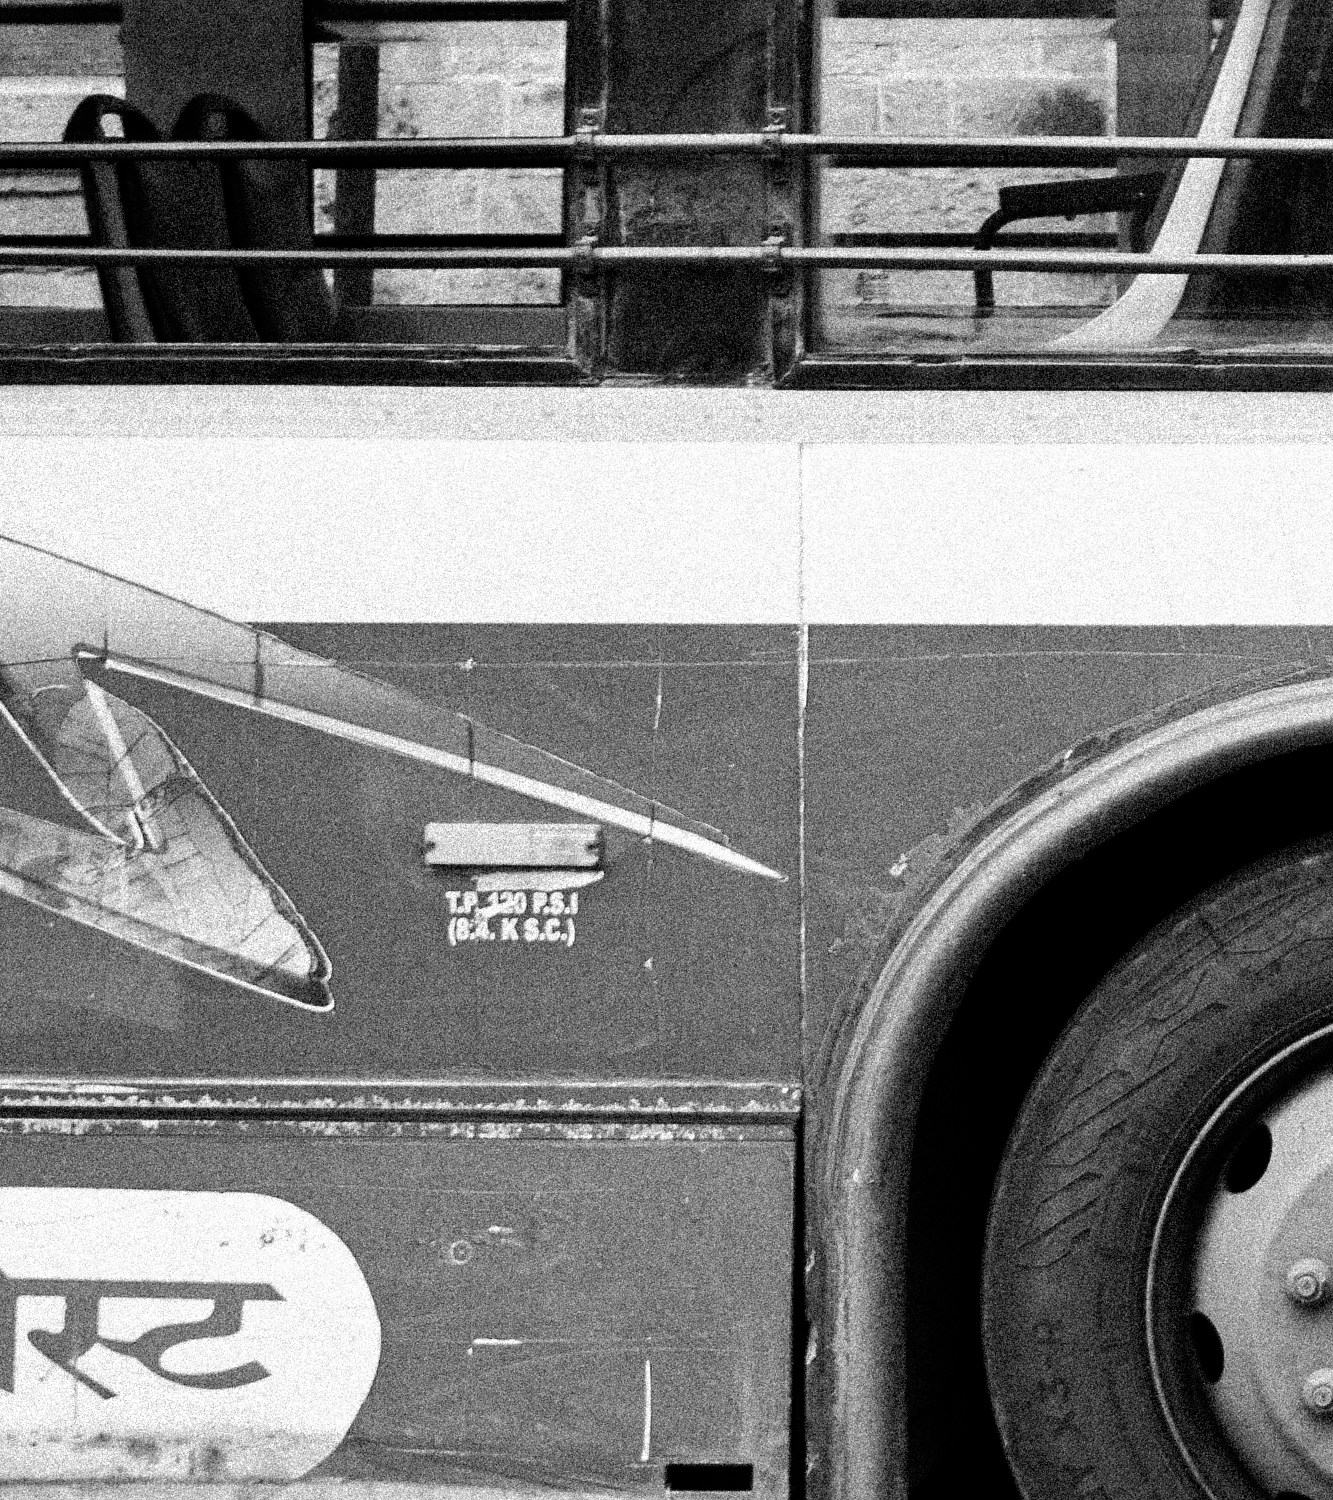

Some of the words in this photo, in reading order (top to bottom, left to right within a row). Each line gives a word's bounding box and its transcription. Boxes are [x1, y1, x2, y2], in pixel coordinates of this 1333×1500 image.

[487, 891, 528, 915] 120
[532, 892, 579, 915] P.S.I
[0, 1268, 288, 1400] स्ट
